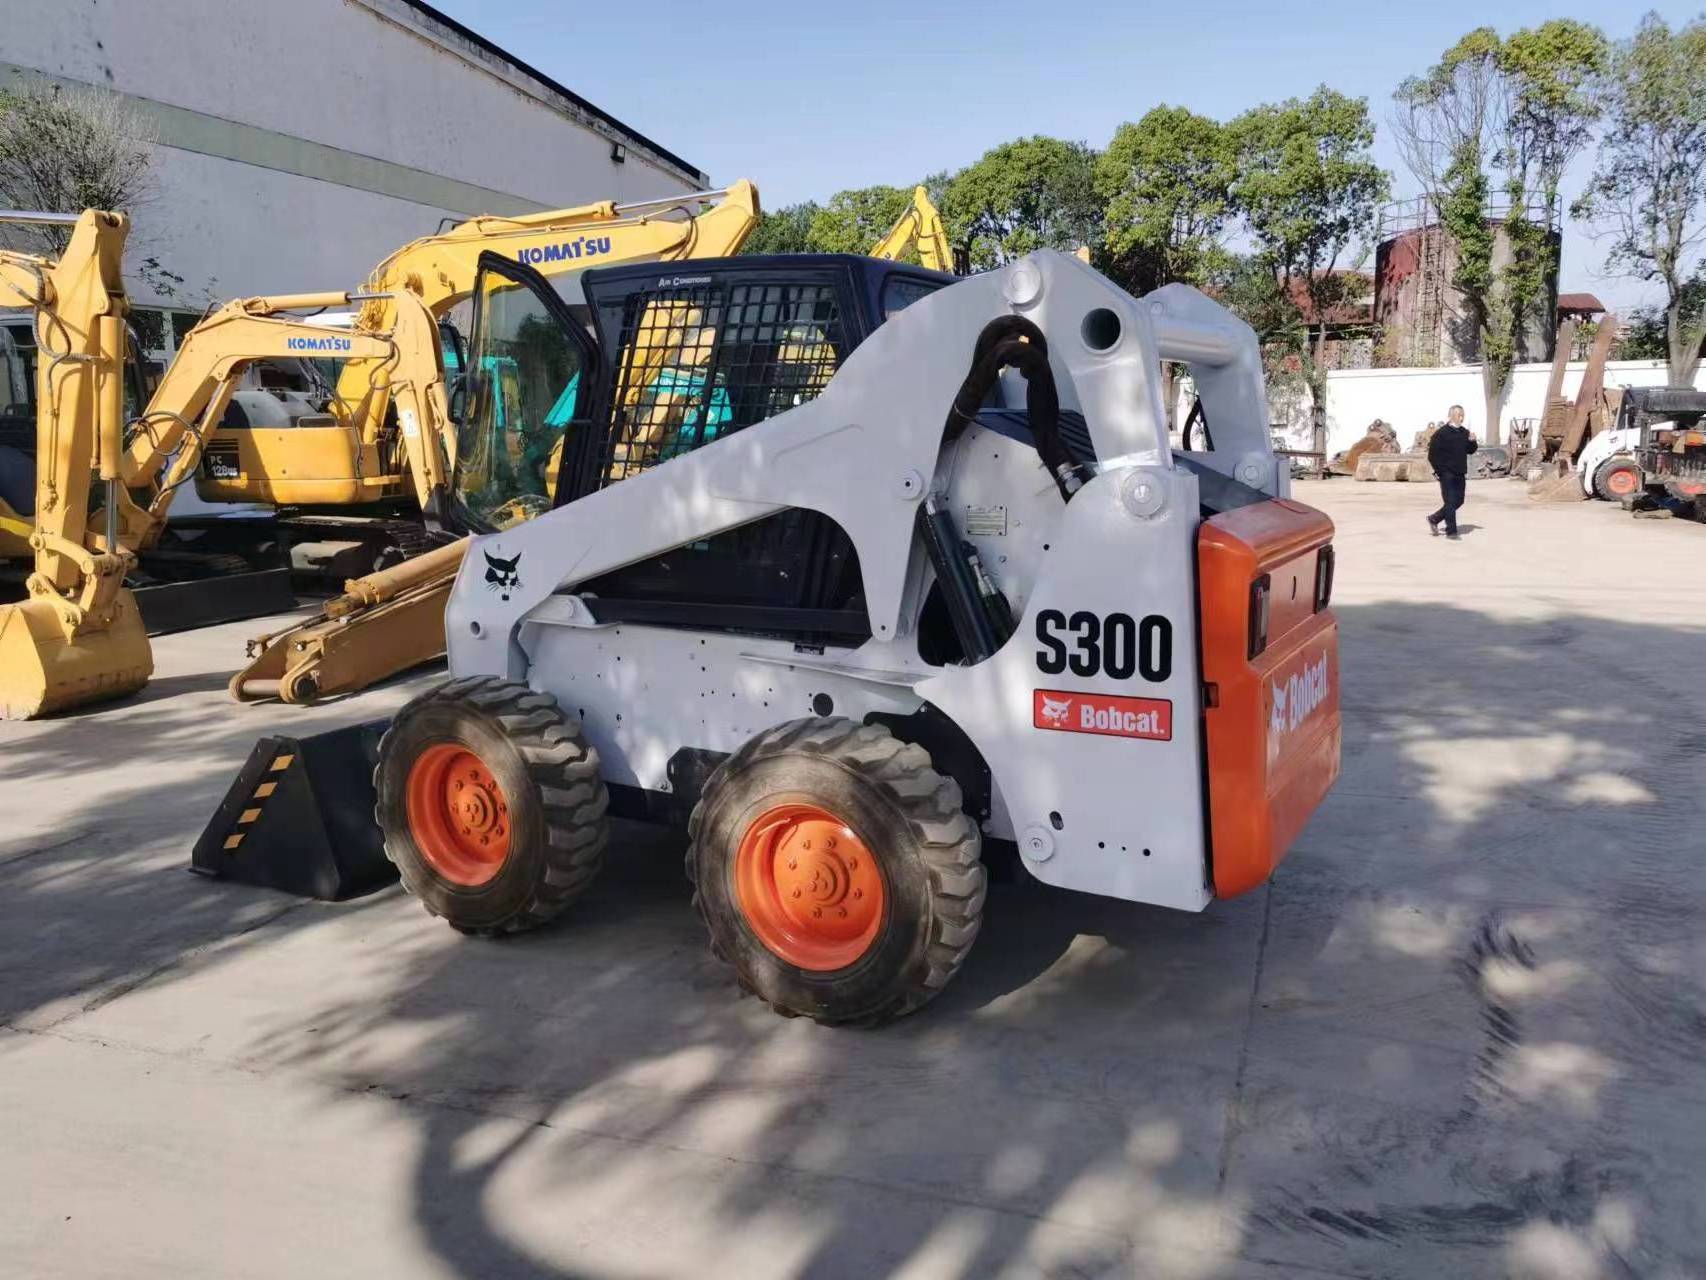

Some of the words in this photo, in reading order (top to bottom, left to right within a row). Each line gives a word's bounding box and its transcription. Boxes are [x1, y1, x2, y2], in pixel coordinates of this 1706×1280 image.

[518, 236, 611, 264] KOMATSU
[288, 336, 351, 350] KOMATSU
[1036, 609, 1172, 682] S300
[1290, 649, 1328, 731] Bobcat
